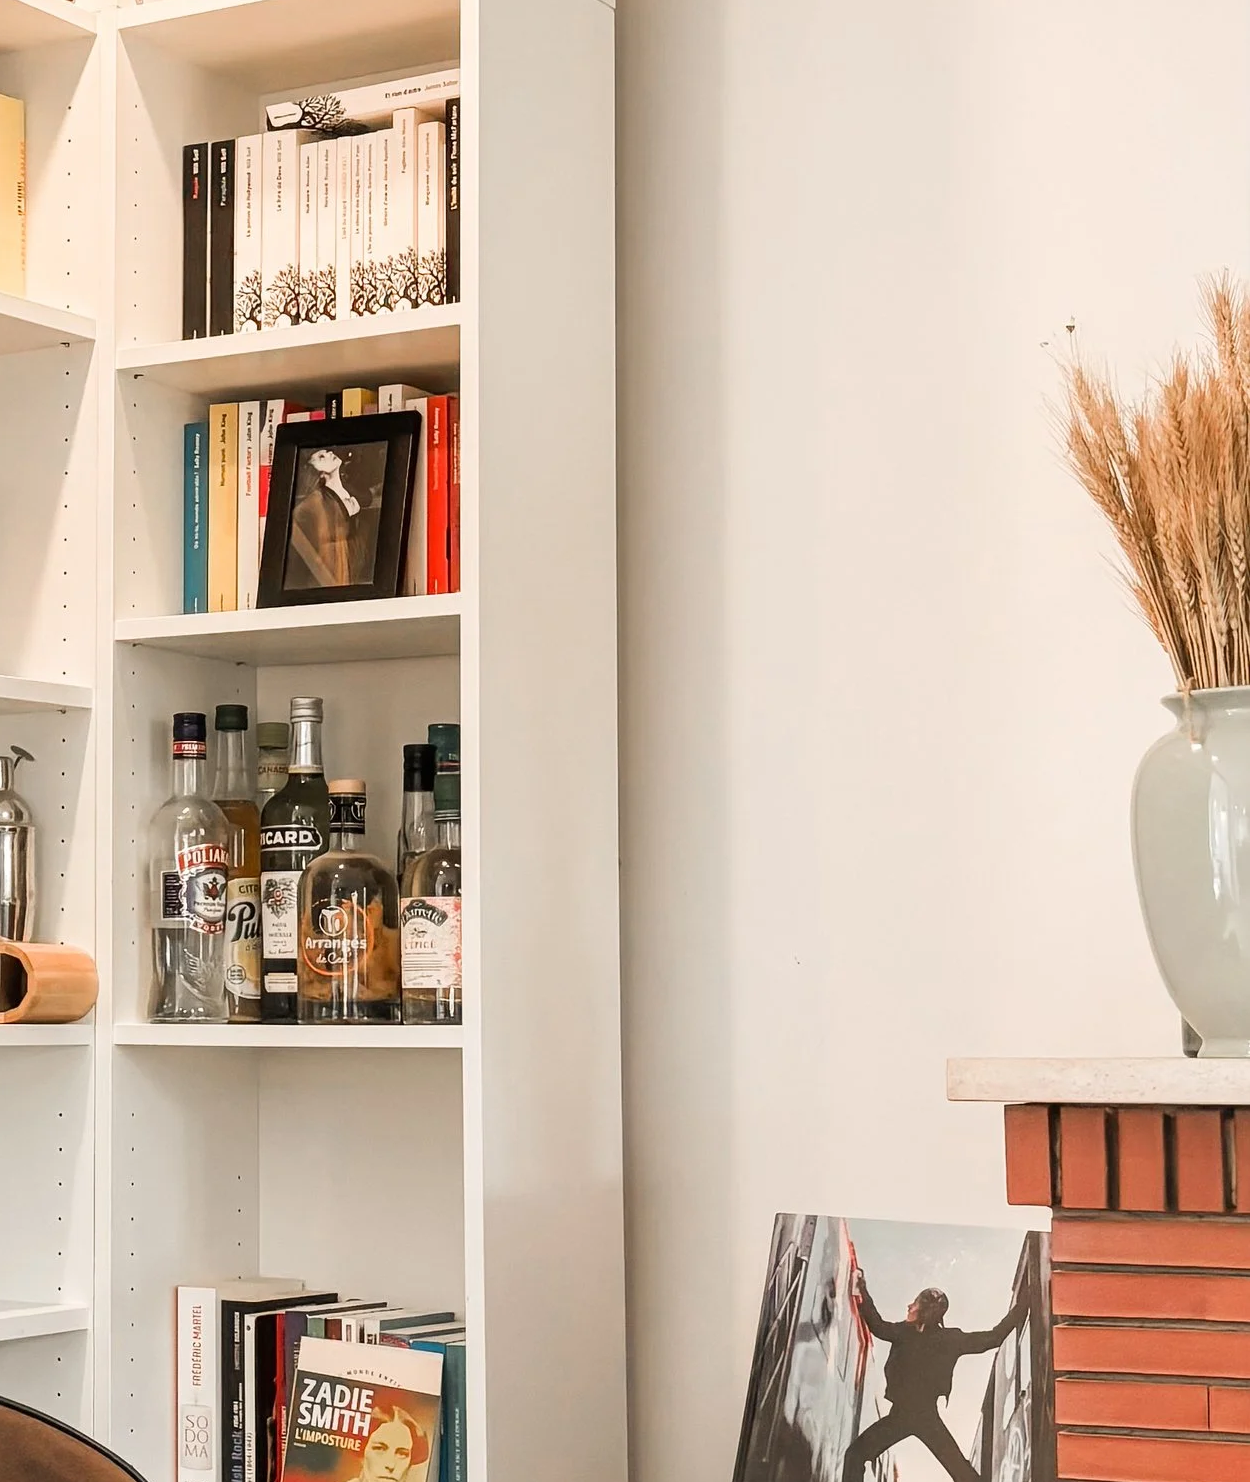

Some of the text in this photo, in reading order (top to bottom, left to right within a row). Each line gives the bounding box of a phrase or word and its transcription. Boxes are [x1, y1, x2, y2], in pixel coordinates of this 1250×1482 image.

[260, 830, 317, 845] ICARD
[191, 1304, 202, 1387] FRÉDÉRIC MARTEL
[299, 1379, 374, 1413] ZADIE
[185, 1414, 208, 1429] SO
[297, 1403, 371, 1437] SMITH
[185, 1429, 209, 1443] DO
[231, 1429, 243, 1460] Rock
[294, 1427, 362, 1452] L'IMPOSTURE
[185, 1445, 209, 1458] MA
